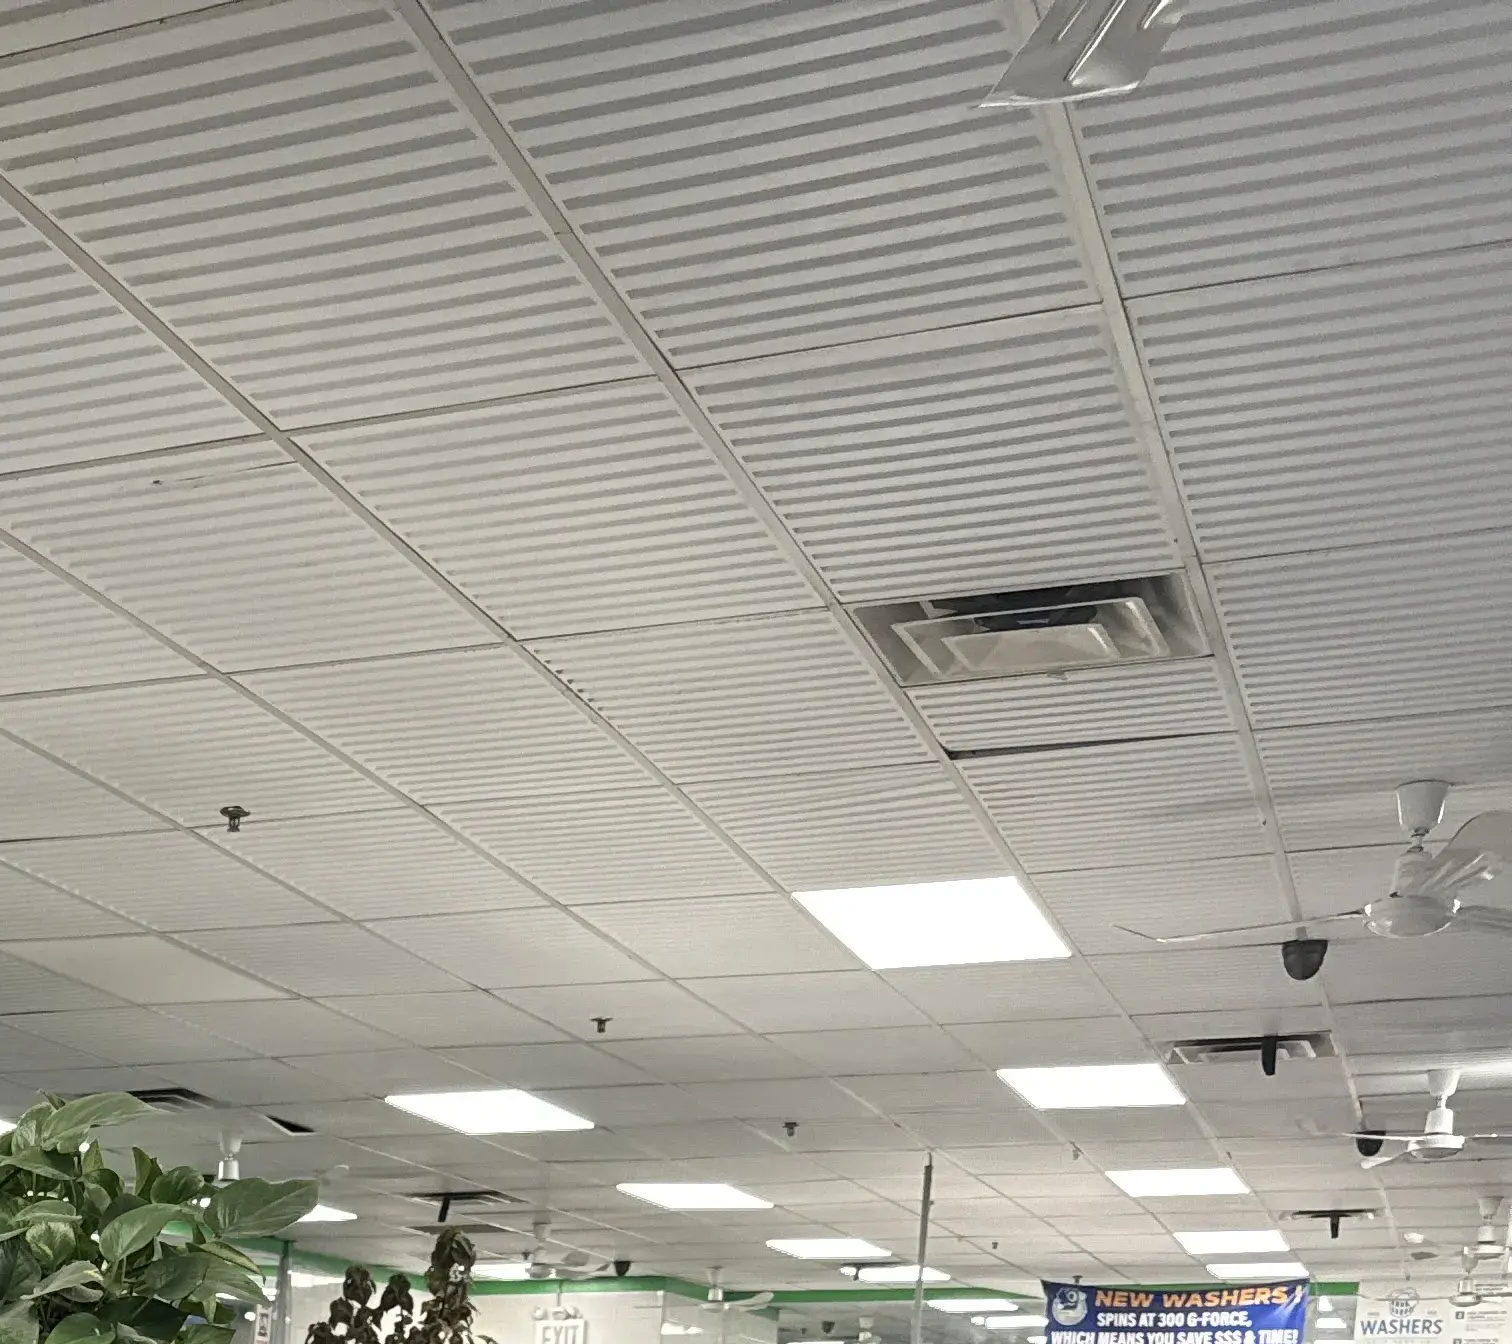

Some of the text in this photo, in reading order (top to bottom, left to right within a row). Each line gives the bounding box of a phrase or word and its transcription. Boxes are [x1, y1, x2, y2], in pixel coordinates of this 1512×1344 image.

[1095, 1286, 1288, 1308] NEW WASHERS
[1097, 1312, 1185, 1328] SPINS AT 300
[1360, 1319, 1444, 1335] WASHERS
